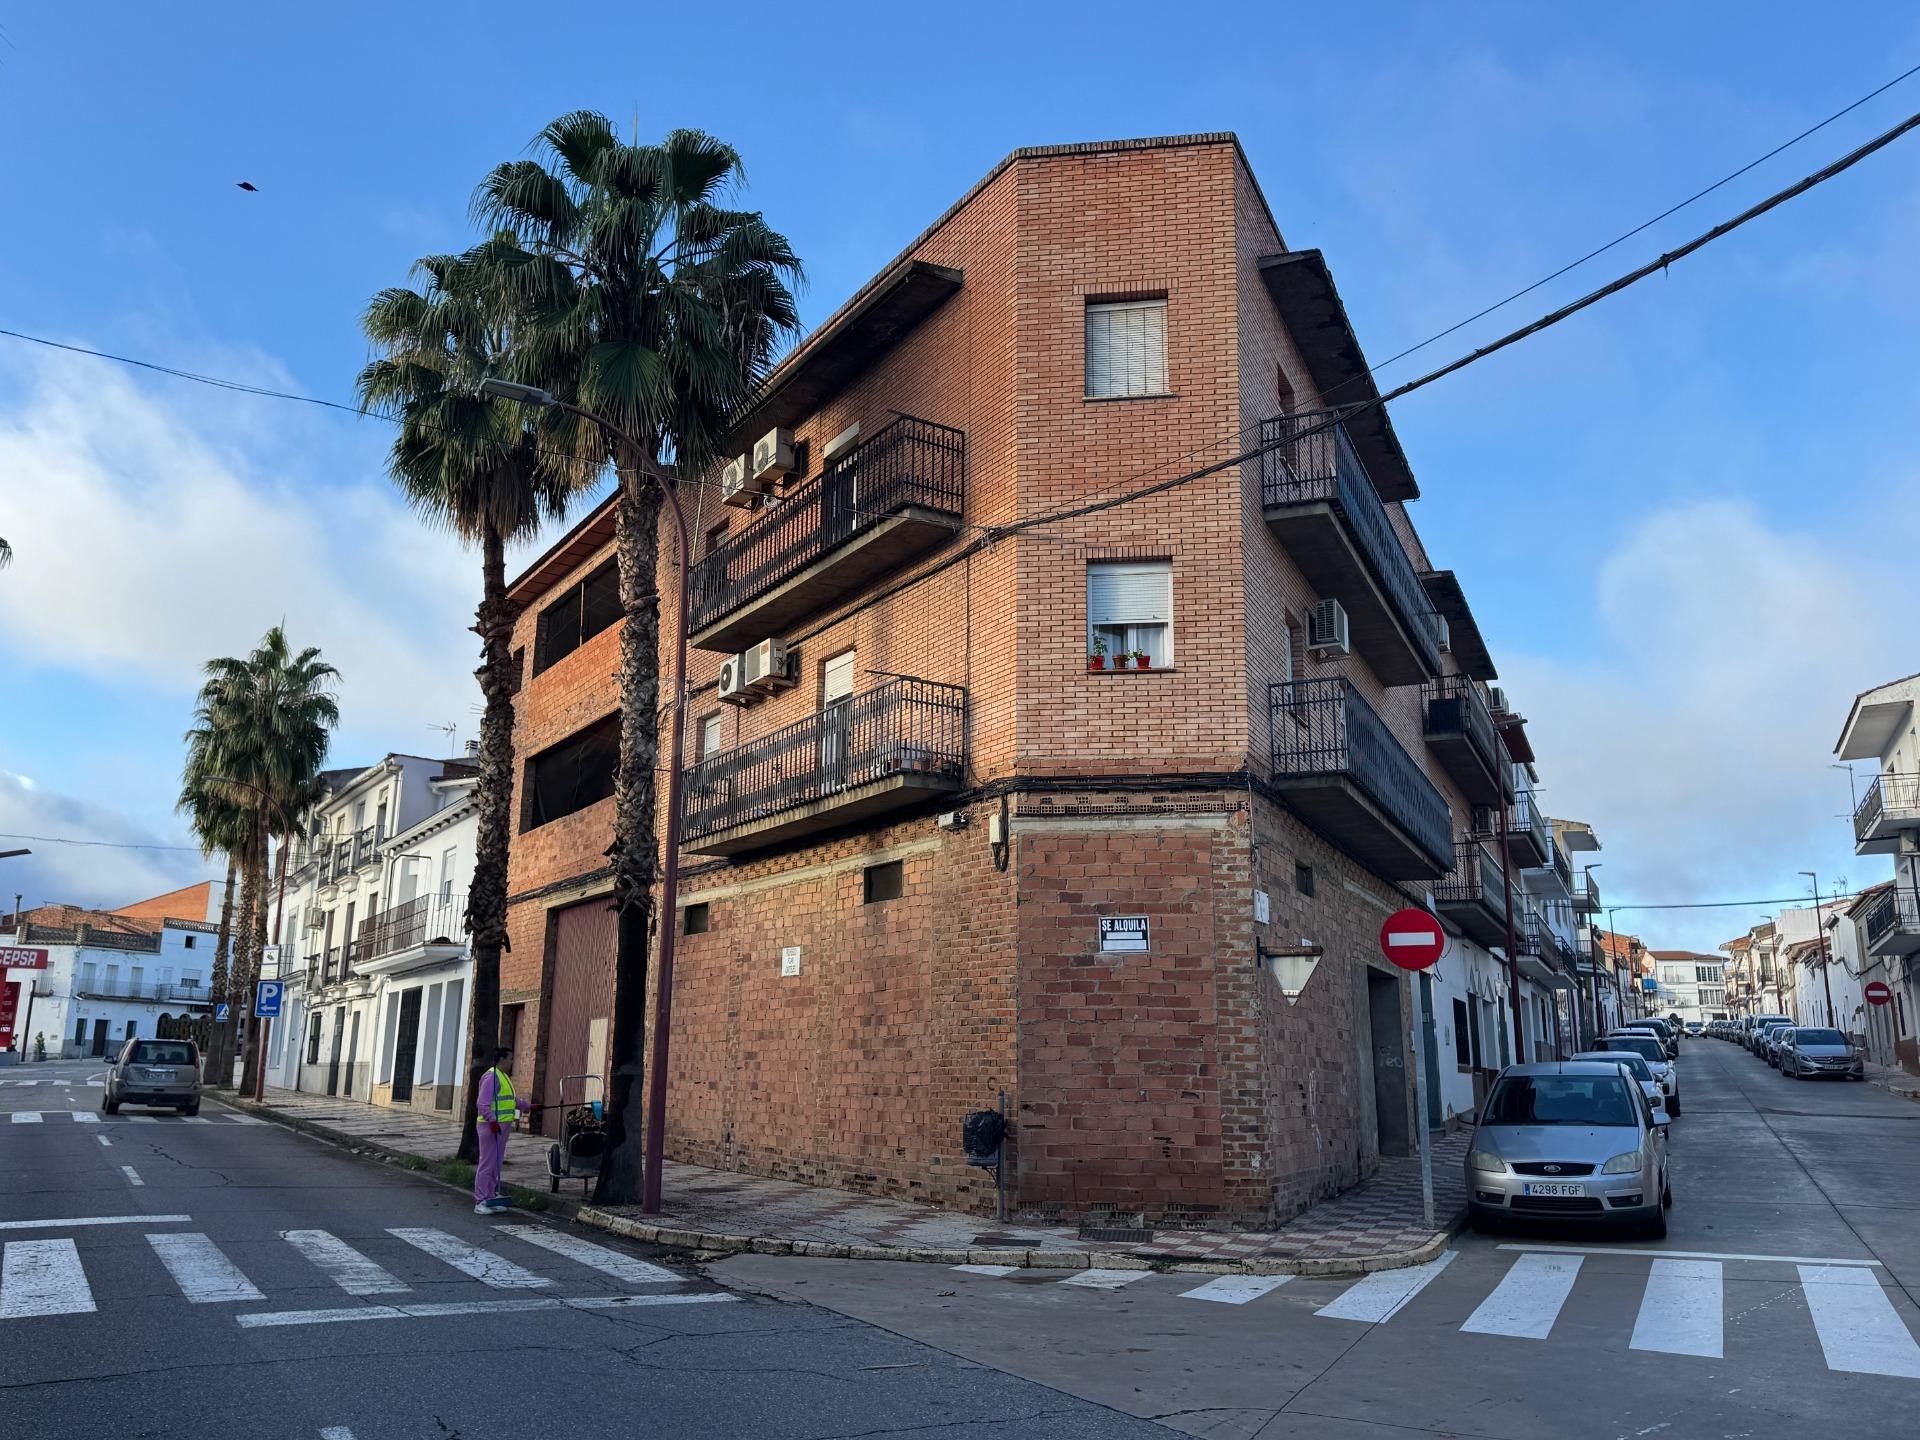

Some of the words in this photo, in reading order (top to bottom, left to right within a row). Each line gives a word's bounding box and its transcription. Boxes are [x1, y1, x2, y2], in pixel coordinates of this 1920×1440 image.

[1102, 920, 1112, 931] SE
[1114, 919, 1146, 931] ALQUILA
[261, 983, 278, 1004] P
[1532, 1184, 1558, 1195] 4298
[1561, 1185, 1581, 1195] FGF
